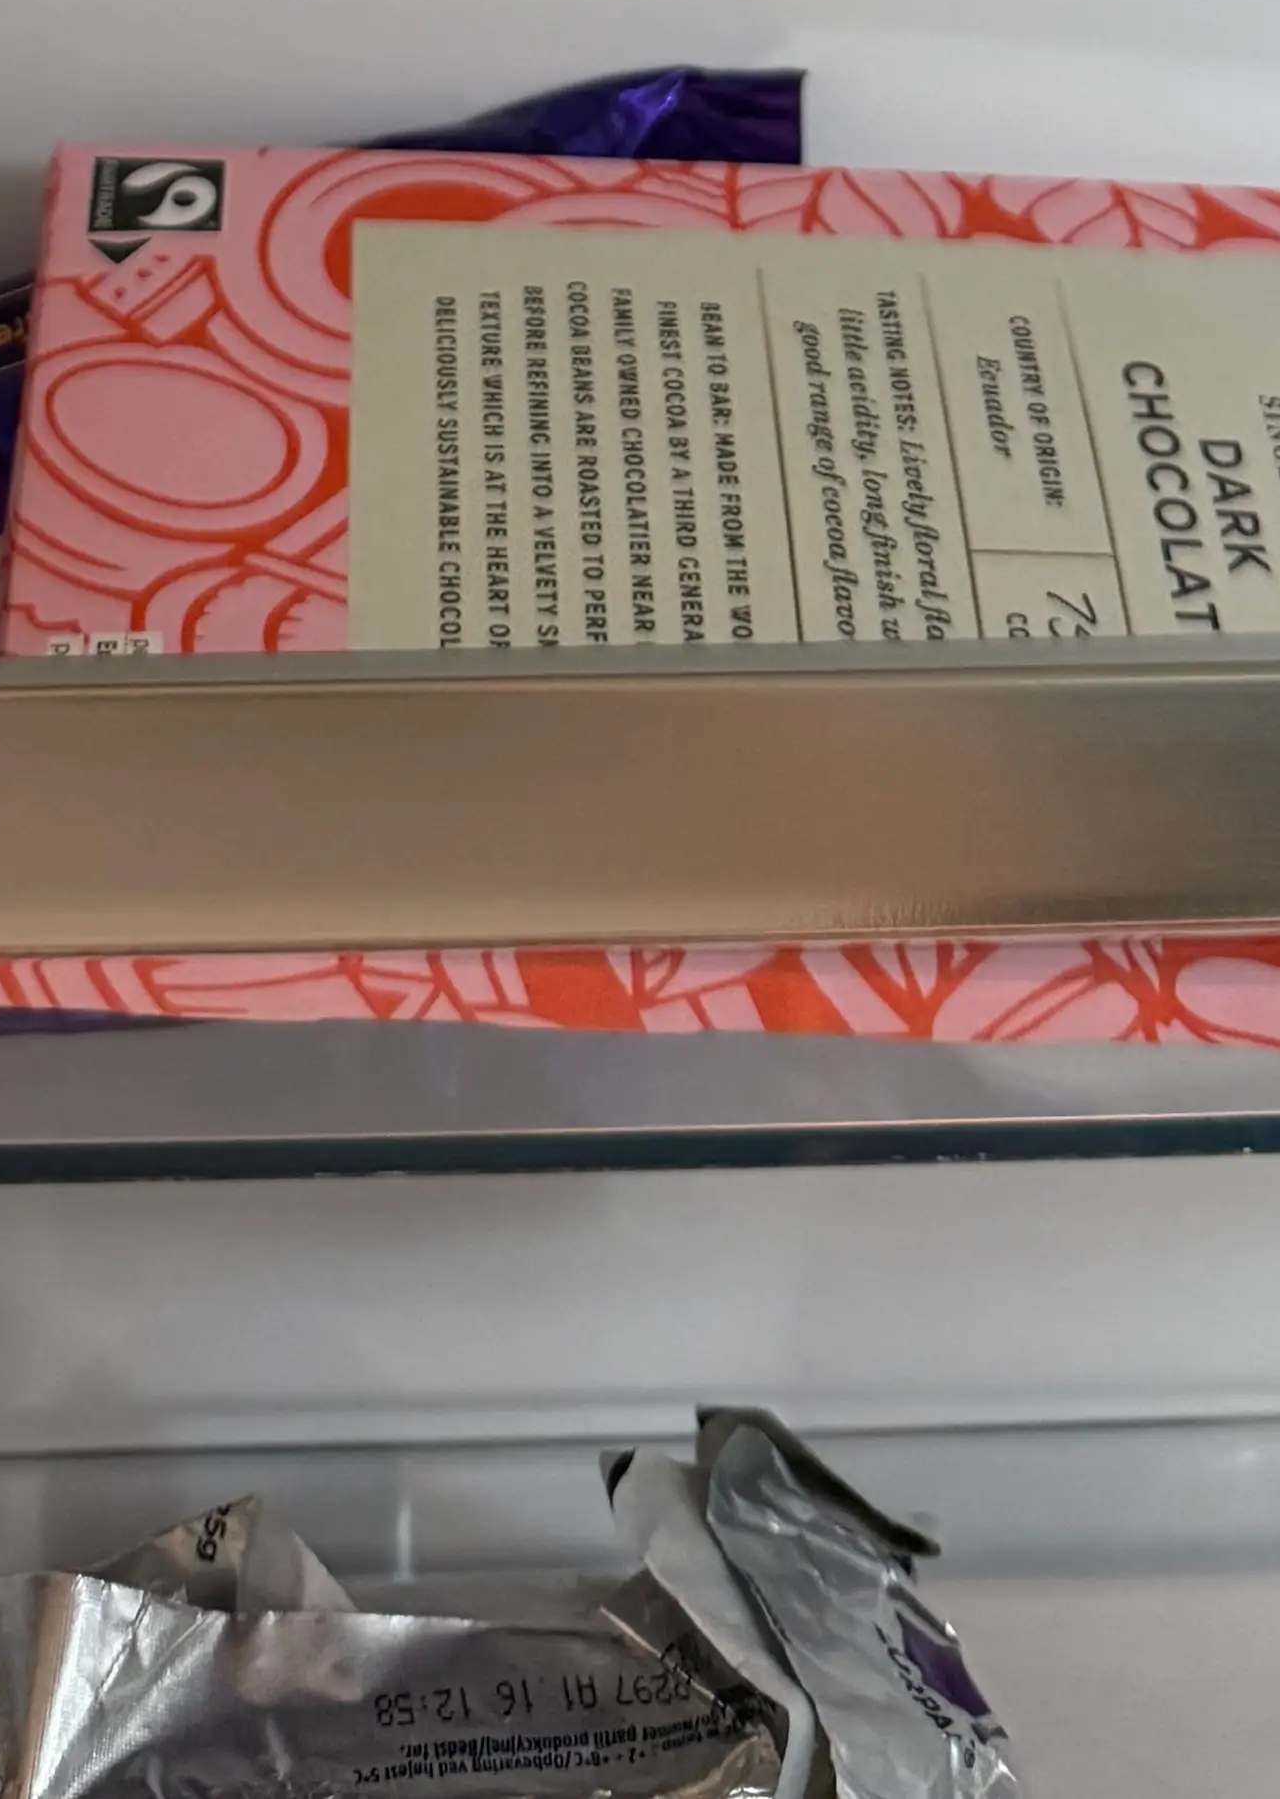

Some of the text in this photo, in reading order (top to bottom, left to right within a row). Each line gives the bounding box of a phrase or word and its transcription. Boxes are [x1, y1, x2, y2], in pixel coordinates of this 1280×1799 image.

[479, 290, 503, 367] TEXTURE
[523, 285, 547, 351] BEFORE
[567, 280, 591, 339] COCOA
[657, 300, 682, 367] FINEST
[699, 301, 725, 348] BEAN
[837, 307, 869, 363] little
[876, 289, 907, 364] TASTING
[434, 295, 458, 413] DELICIOUSLY
[570, 345, 594, 405] BEANS
[705, 354, 728, 376] TO
[792, 319, 832, 378] good
[1008, 314, 1046, 397] COUNTRY
[481, 373, 505, 437] WHICH
[526, 357, 552, 446] REFINING
[661, 367, 687, 430] COCOA
[709, 381, 734, 427] BAR:
[806, 381, 835, 452] range
[847, 365, 882, 462] acidity,
[890, 366, 918, 433] NOTES:
[976, 355, 1015, 459] Ecuador
[1026, 401, 1051, 428] OF
[484, 443, 506, 464] IS
[575, 411, 598, 448] ARE
[610, 287, 656, 633] FAMILY OWNED CHOCOLATIER NEAR
[667, 436, 691, 463] BY
[714, 431, 740, 485] MADE
[436, 418, 462, 553] SUSTAINABLE
[484, 470, 506, 493] AT
[530, 452, 553, 498] INTO
[577, 454, 604, 546] ROASTED
[671, 467, 693, 480] A
[811, 457, 846, 489] of
[859, 469, 889, 527] long
[900, 438, 935, 520] Lively
[485, 499, 508, 540] THE
[533, 506, 554, 519] A
[672, 488, 698, 548] THIRD
[719, 492, 746, 551] FROM
[821, 486, 848, 566] cocoa
[1198, 438, 1273, 579] DARK
[486, 545, 510, 615] HEART
[534, 525, 559, 618] VELVETY
[583, 554, 605, 581] TO
[725, 557, 750, 596] THE
[863, 520, 905, 606] finish
[905, 516, 949, 602] floral
